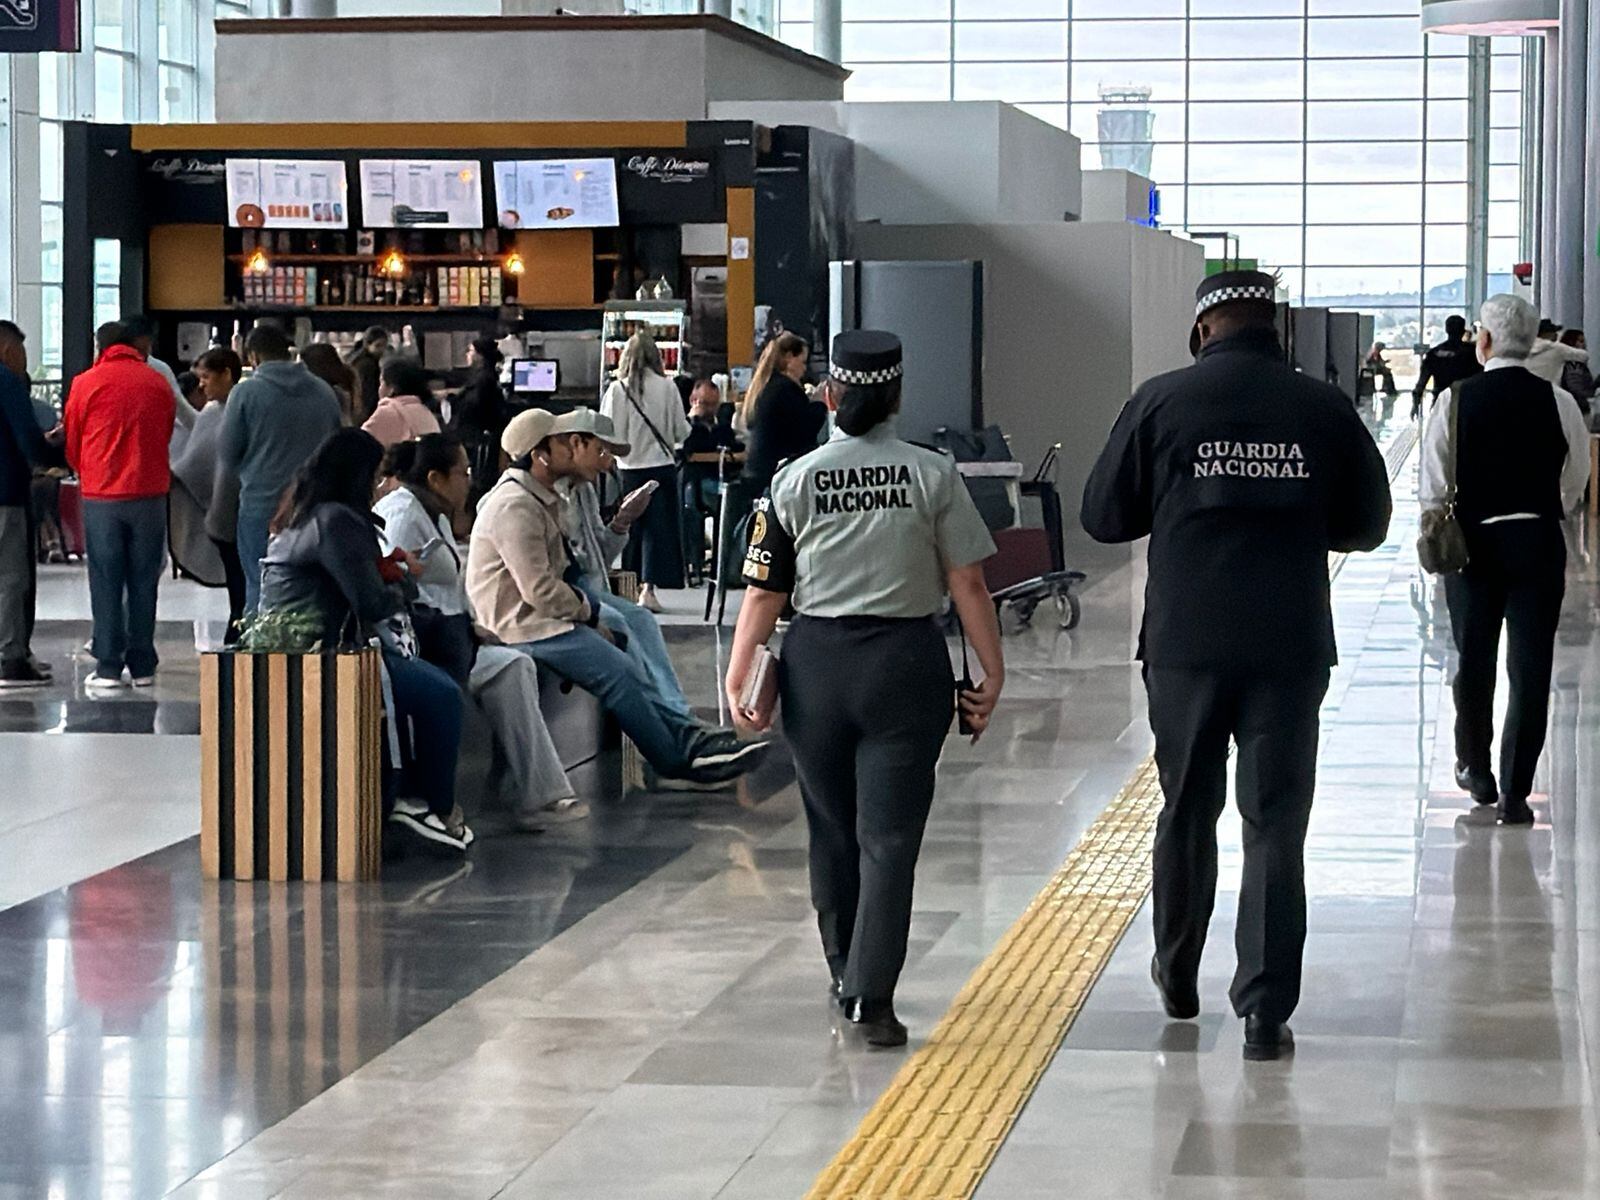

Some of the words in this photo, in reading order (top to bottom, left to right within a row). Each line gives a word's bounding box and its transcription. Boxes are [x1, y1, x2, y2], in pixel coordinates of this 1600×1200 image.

[1197, 441, 1304, 459] GUARDIA
[1193, 459, 1310, 478] NACIONAL
[814, 465, 912, 492] GUARDIA
[815, 488, 912, 515] NACIONAL
[746, 545, 772, 564] SEC
